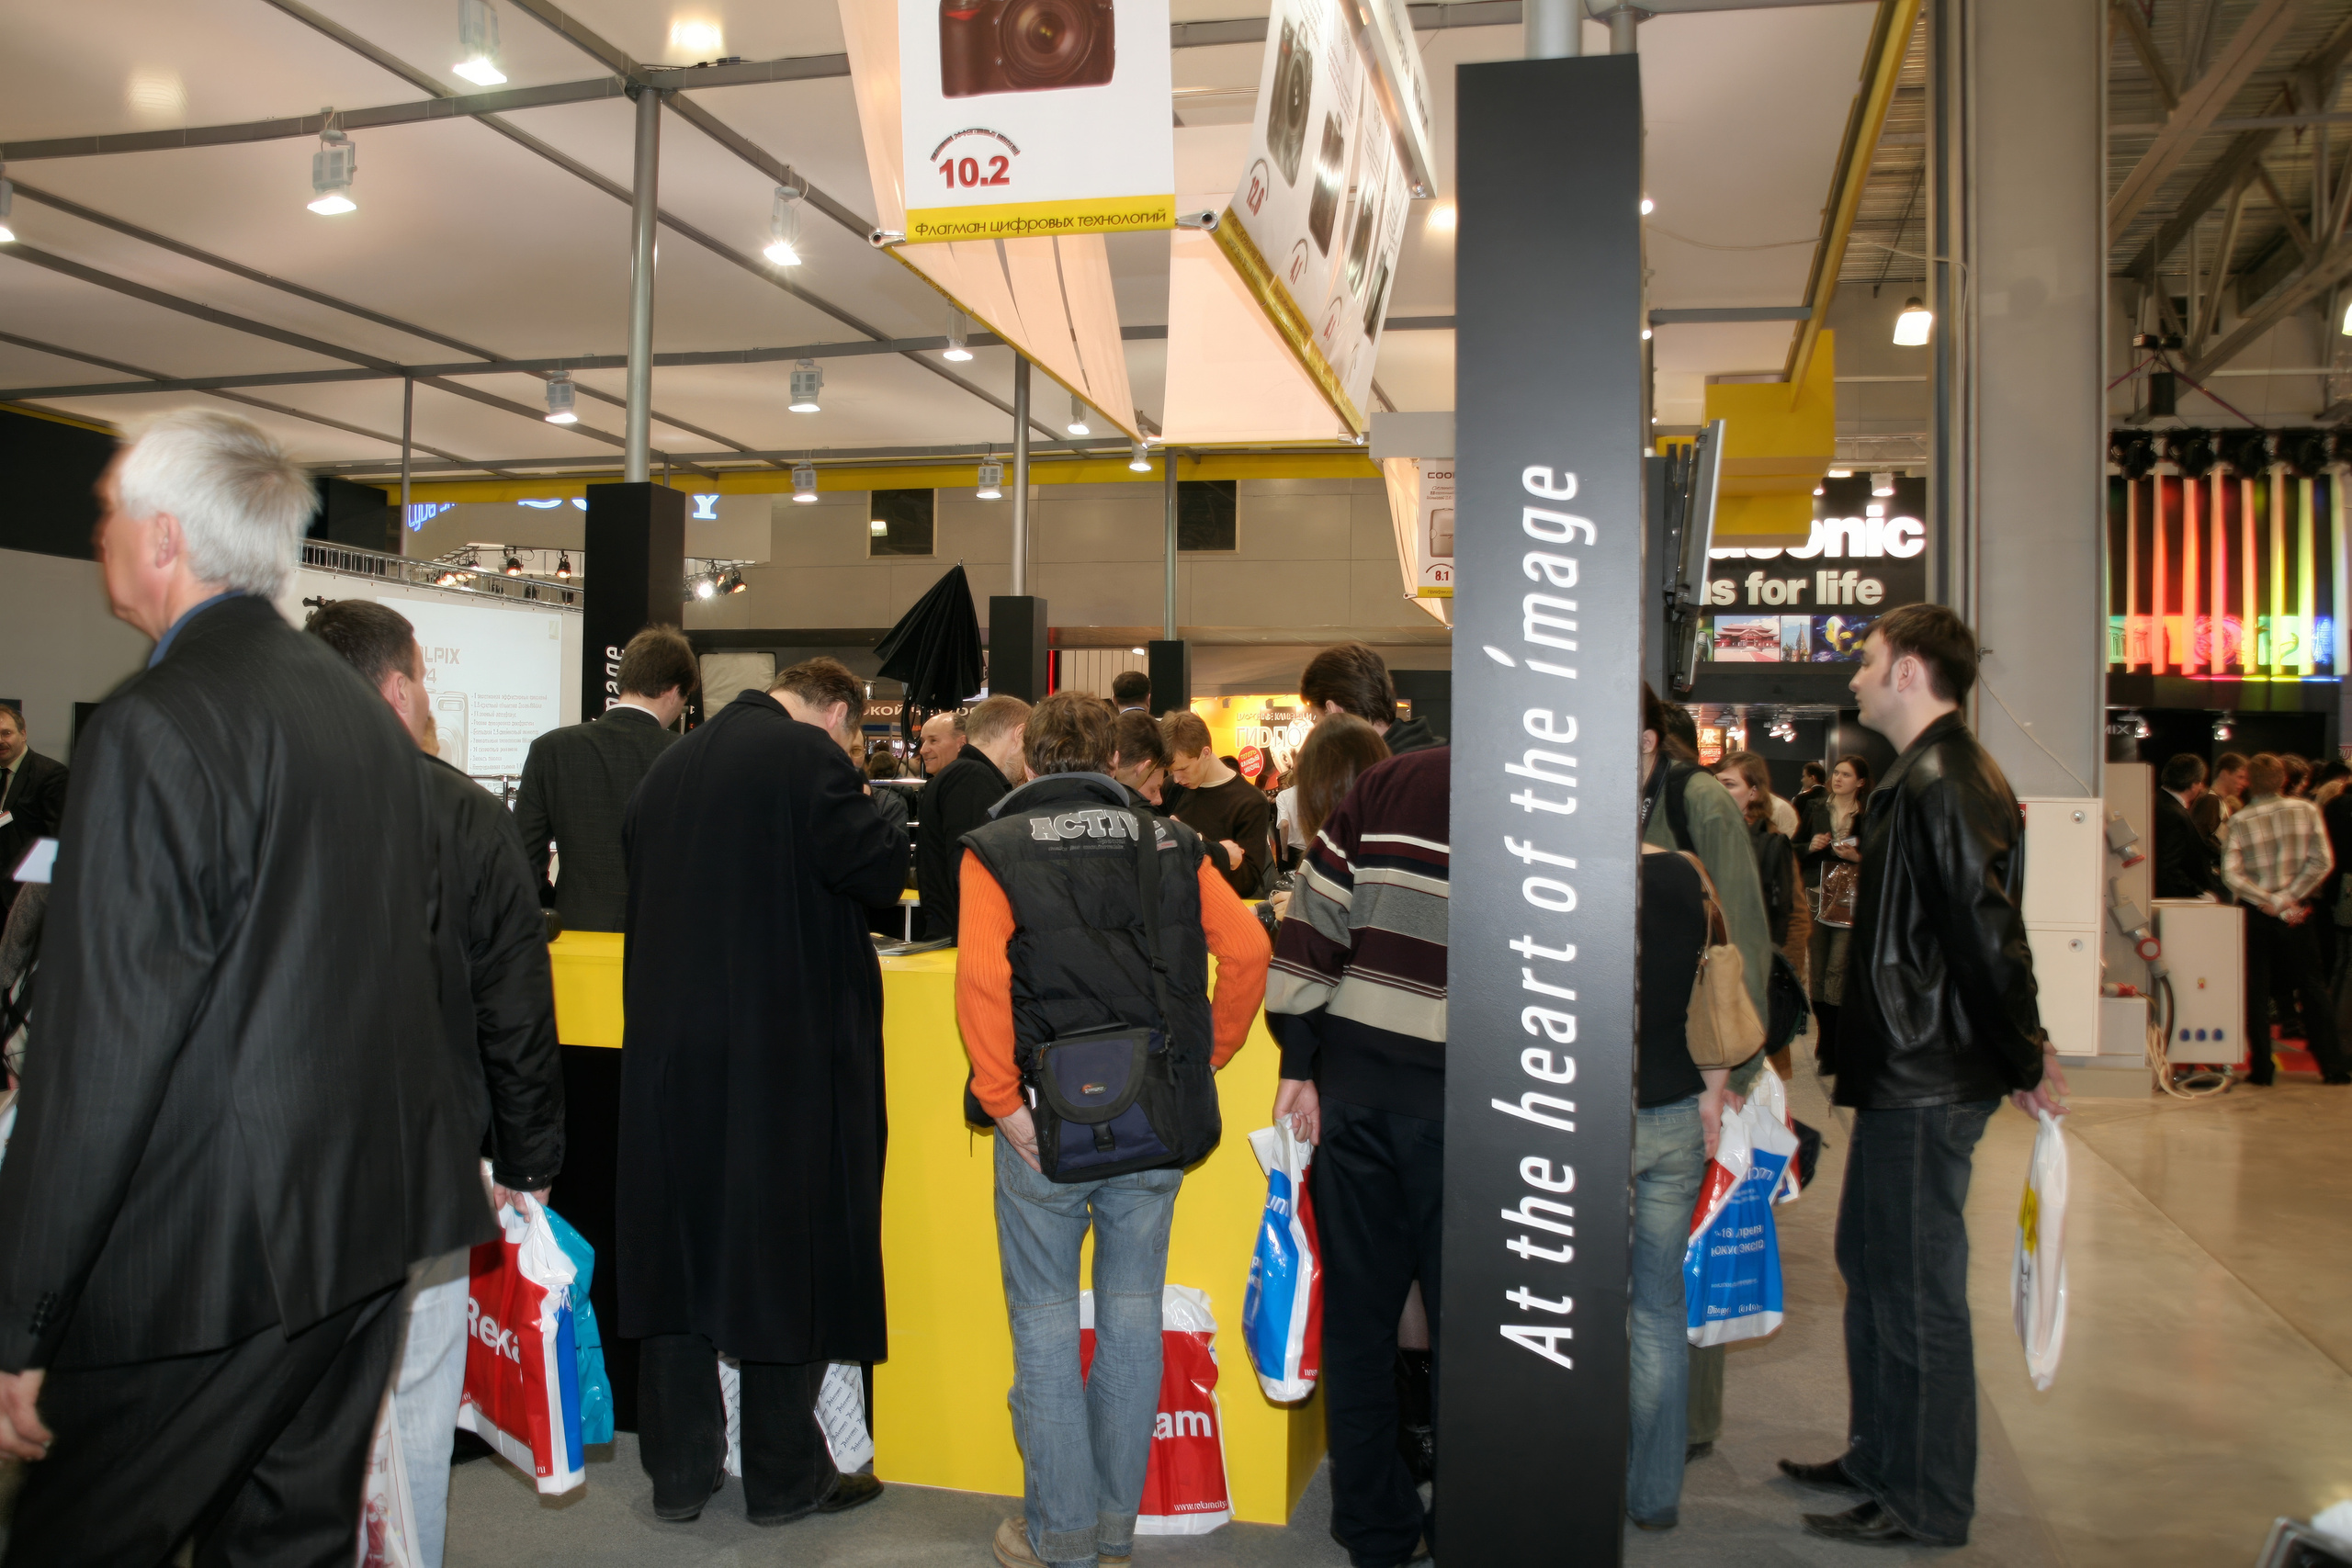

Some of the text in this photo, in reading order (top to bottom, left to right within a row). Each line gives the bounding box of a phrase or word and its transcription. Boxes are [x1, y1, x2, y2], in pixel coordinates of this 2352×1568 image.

[938, 155, 1011, 189] 10.2
[915, 209, 1167, 236] Флагман цифровых технологий
[1745, 570, 1806, 606] for
[1815, 570, 1883, 606] life
[1482, 465, 1598, 1371] At the heart of the image
